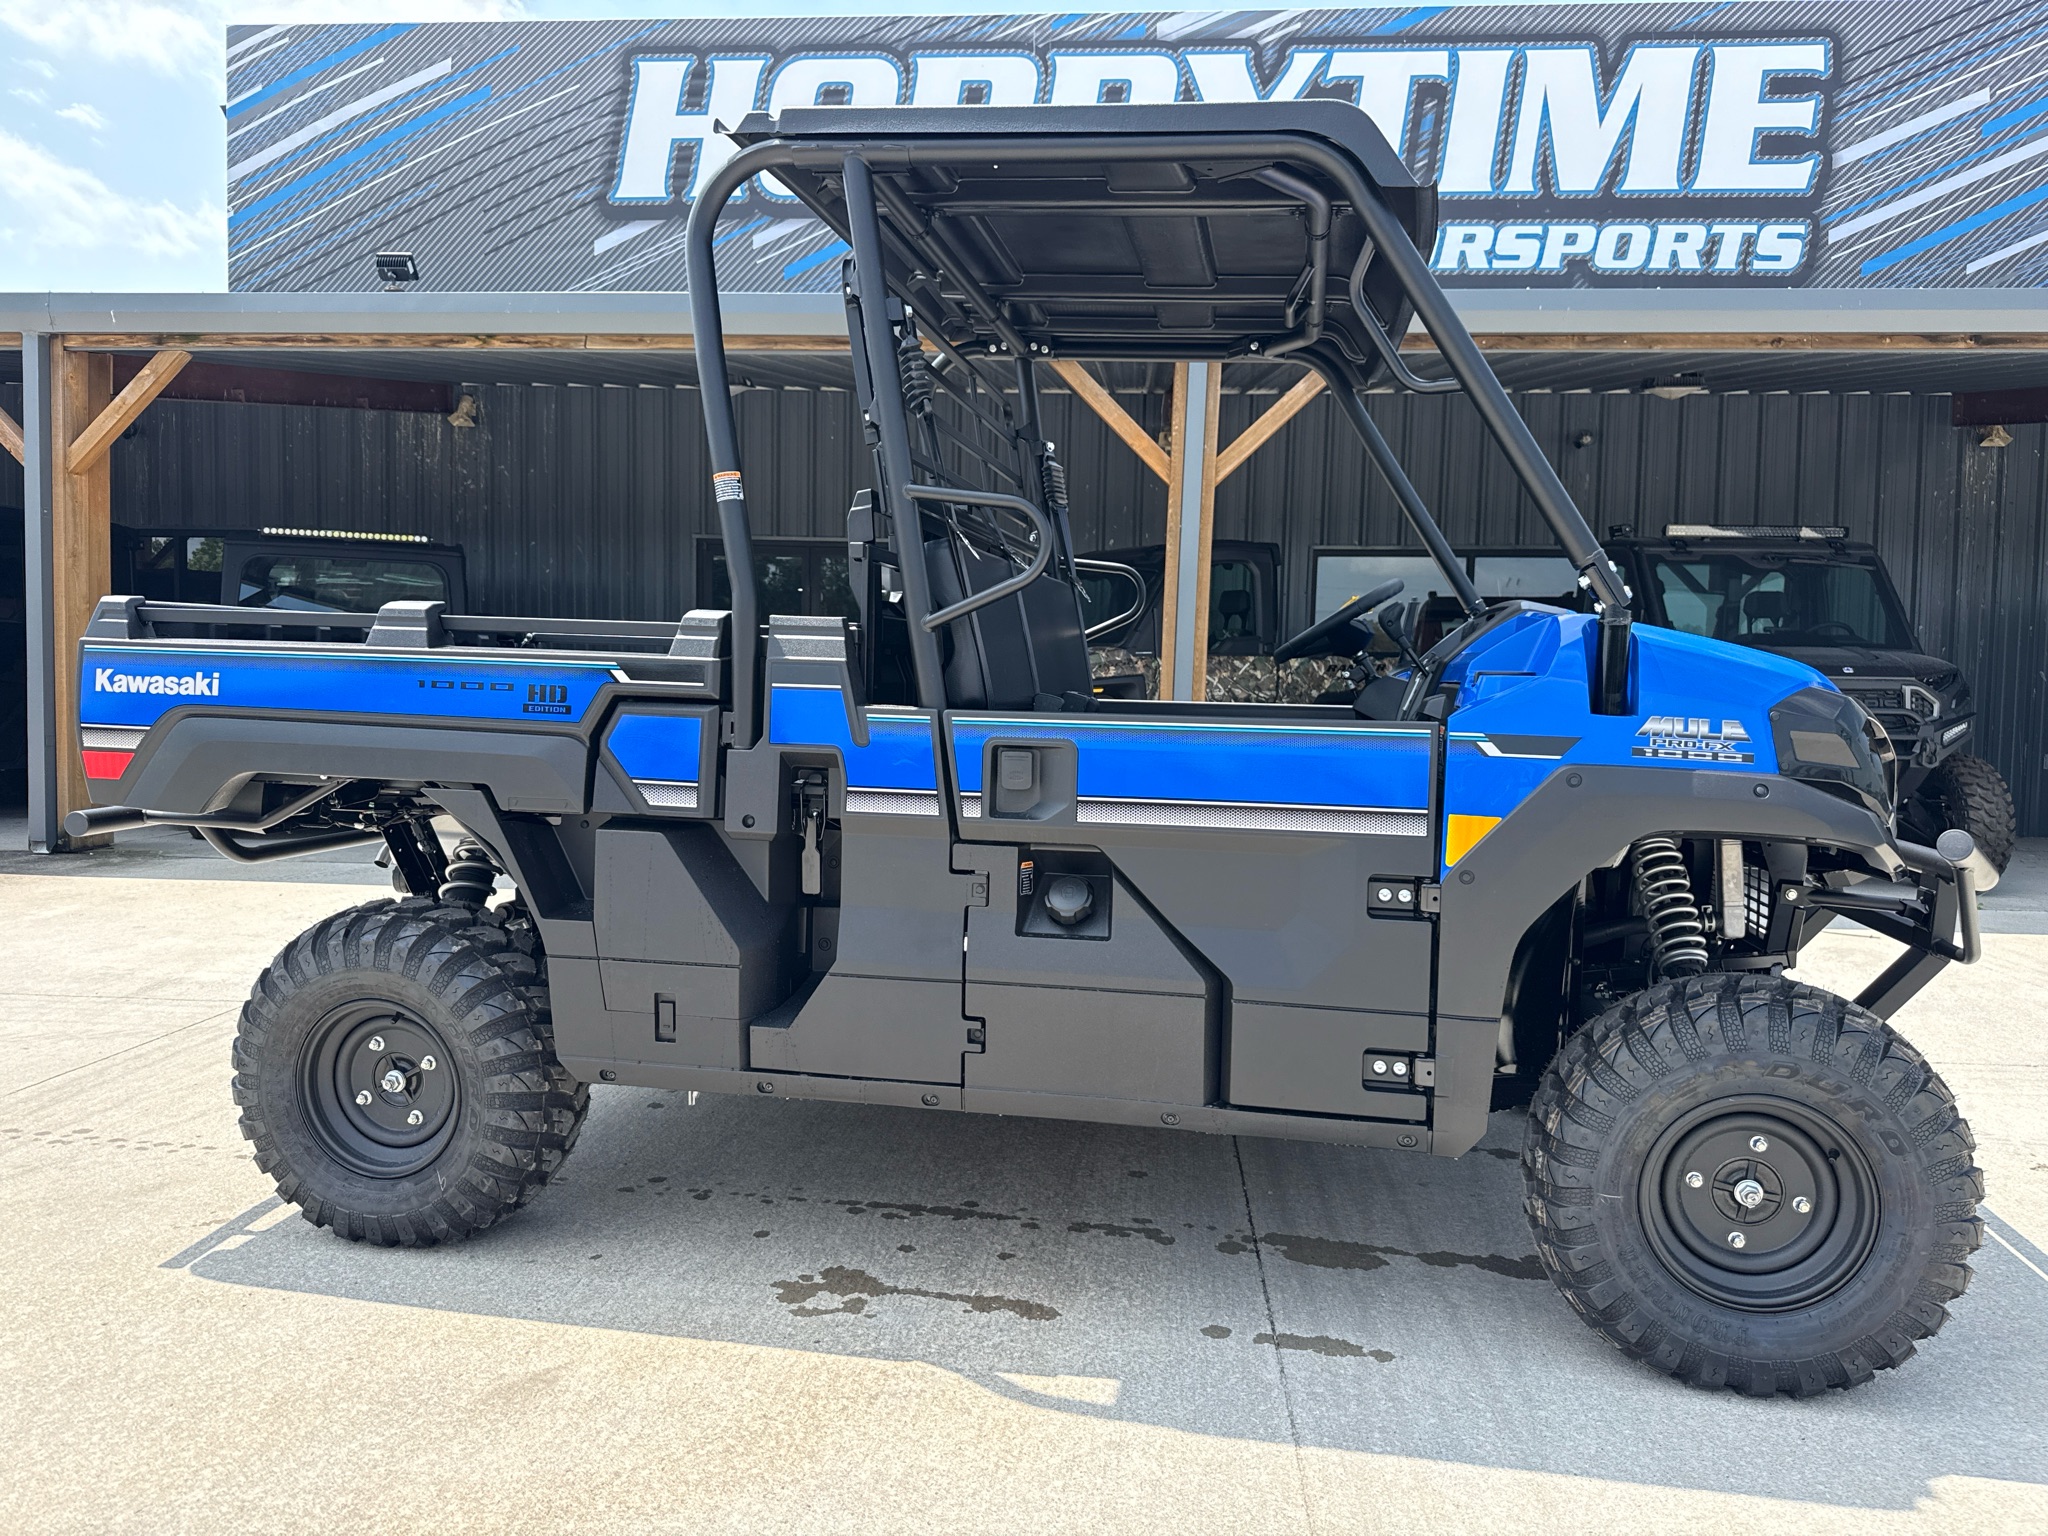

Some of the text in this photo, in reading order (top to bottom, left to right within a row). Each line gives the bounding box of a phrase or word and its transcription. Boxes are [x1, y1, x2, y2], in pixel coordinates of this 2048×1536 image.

[95, 667, 220, 697] Kawasaki
[417, 679, 568, 704] 1000 HD
[527, 705, 567, 713] EDITION
[1635, 715, 1752, 743] MULE
[1643, 748, 1743, 762] 1000
[1650, 738, 1736, 752] PRO-FX
[1762, 1060, 1912, 1157] DURO
